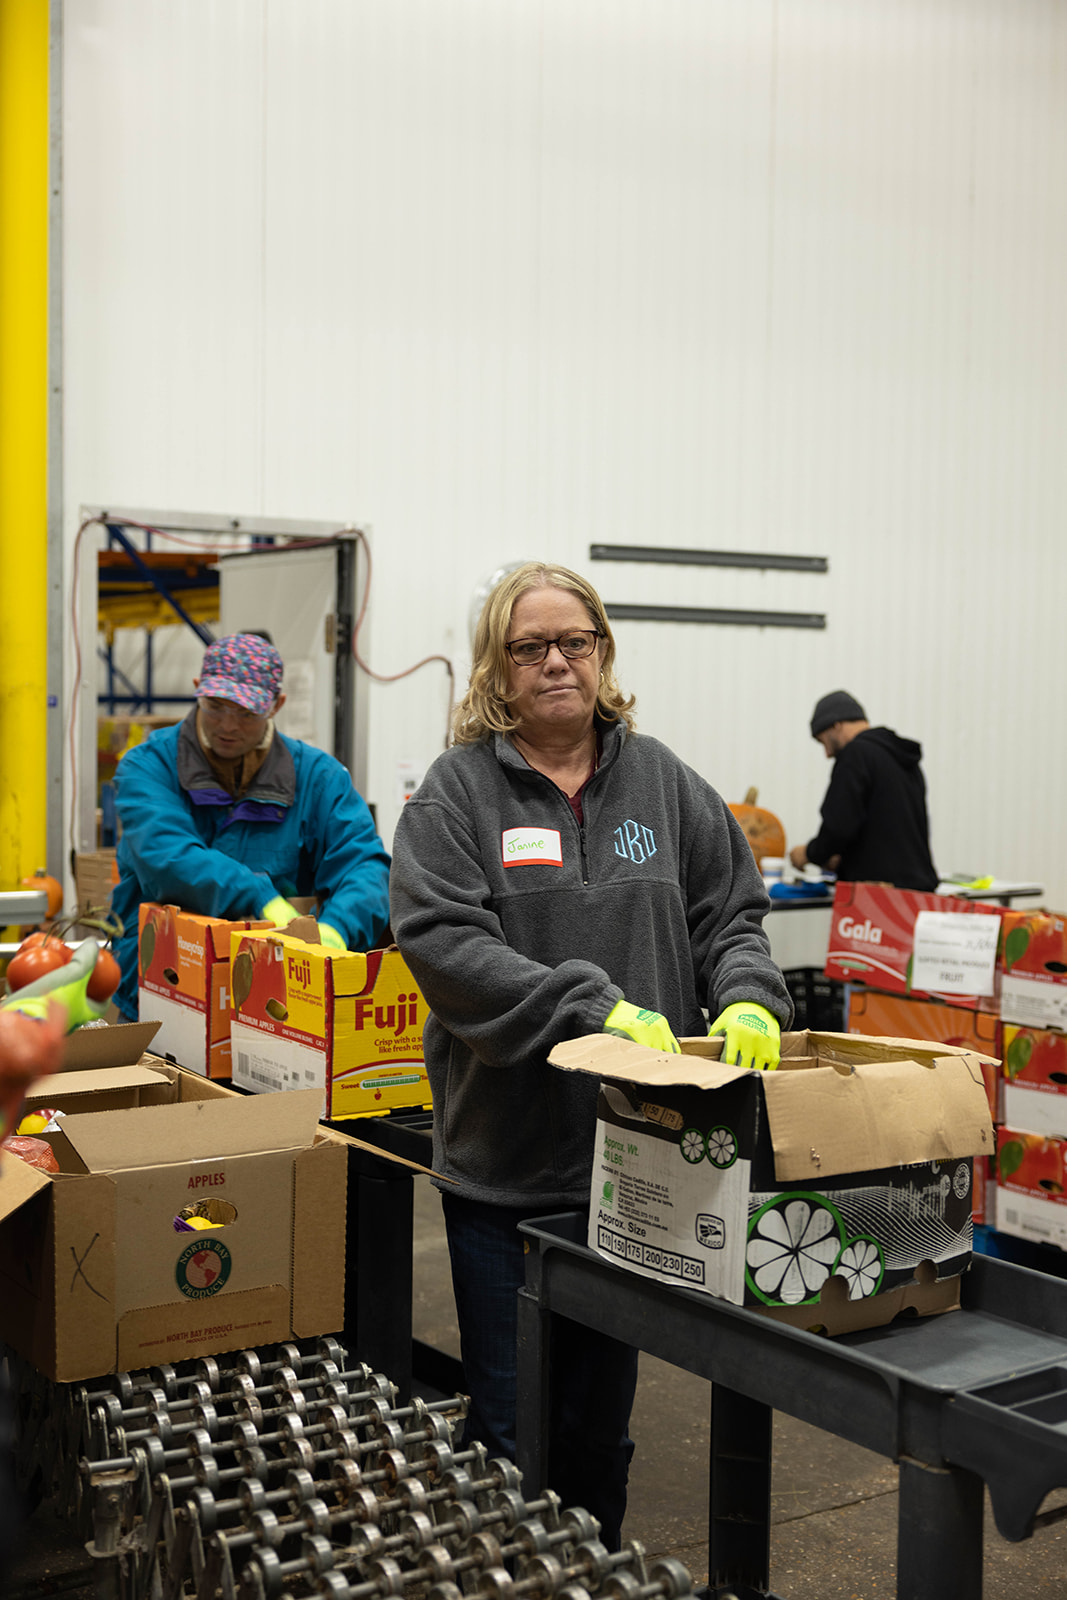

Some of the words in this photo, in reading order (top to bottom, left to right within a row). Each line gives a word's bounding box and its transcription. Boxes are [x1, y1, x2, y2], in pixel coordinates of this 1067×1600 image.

[507, 837, 545, 854] Janine
[838, 916, 883, 944] Gala
[177, 935, 204, 960] Honeycrisp
[288, 957, 312, 990] Fuji
[940, 971, 964, 983] FRUIT
[238, 1013, 259, 1027] PREMIUM
[259, 1020, 276, 1033] APPLES
[354, 992, 418, 1037] Fuji
[374, 1037, 393, 1047] Crisp
[394, 1036, 411, 1045] with
[378, 1045, 392, 1053] like
[393, 1043, 411, 1052] fresh
[340, 1082, 360, 1090] Sweet
[603, 1135, 626, 1153] Approx.
[627, 1143, 640, 1157] Wt.
[611, 1152, 625, 1167] LBS.
[187, 1172, 225, 1189] APPLES
[597, 1209, 626, 1230] Approx.
[627, 1222, 647, 1238] Size
[180, 1240, 211, 1265] NORTH
[214, 1240, 230, 1260] BAY
[601, 1232, 611, 1247] 110
[613, 1238, 625, 1254] 150
[627, 1243, 641, 1259] 175
[645, 1250, 661, 1265] 200
[663, 1256, 680, 1271] 230
[684, 1262, 701, 1277] 250
[181, 1278, 225, 1299] PRODUCE
[166, 1331, 189, 1343] NORTH
[190, 1329, 203, 1339] BAY
[203, 1323, 233, 1336] PRODUCE
